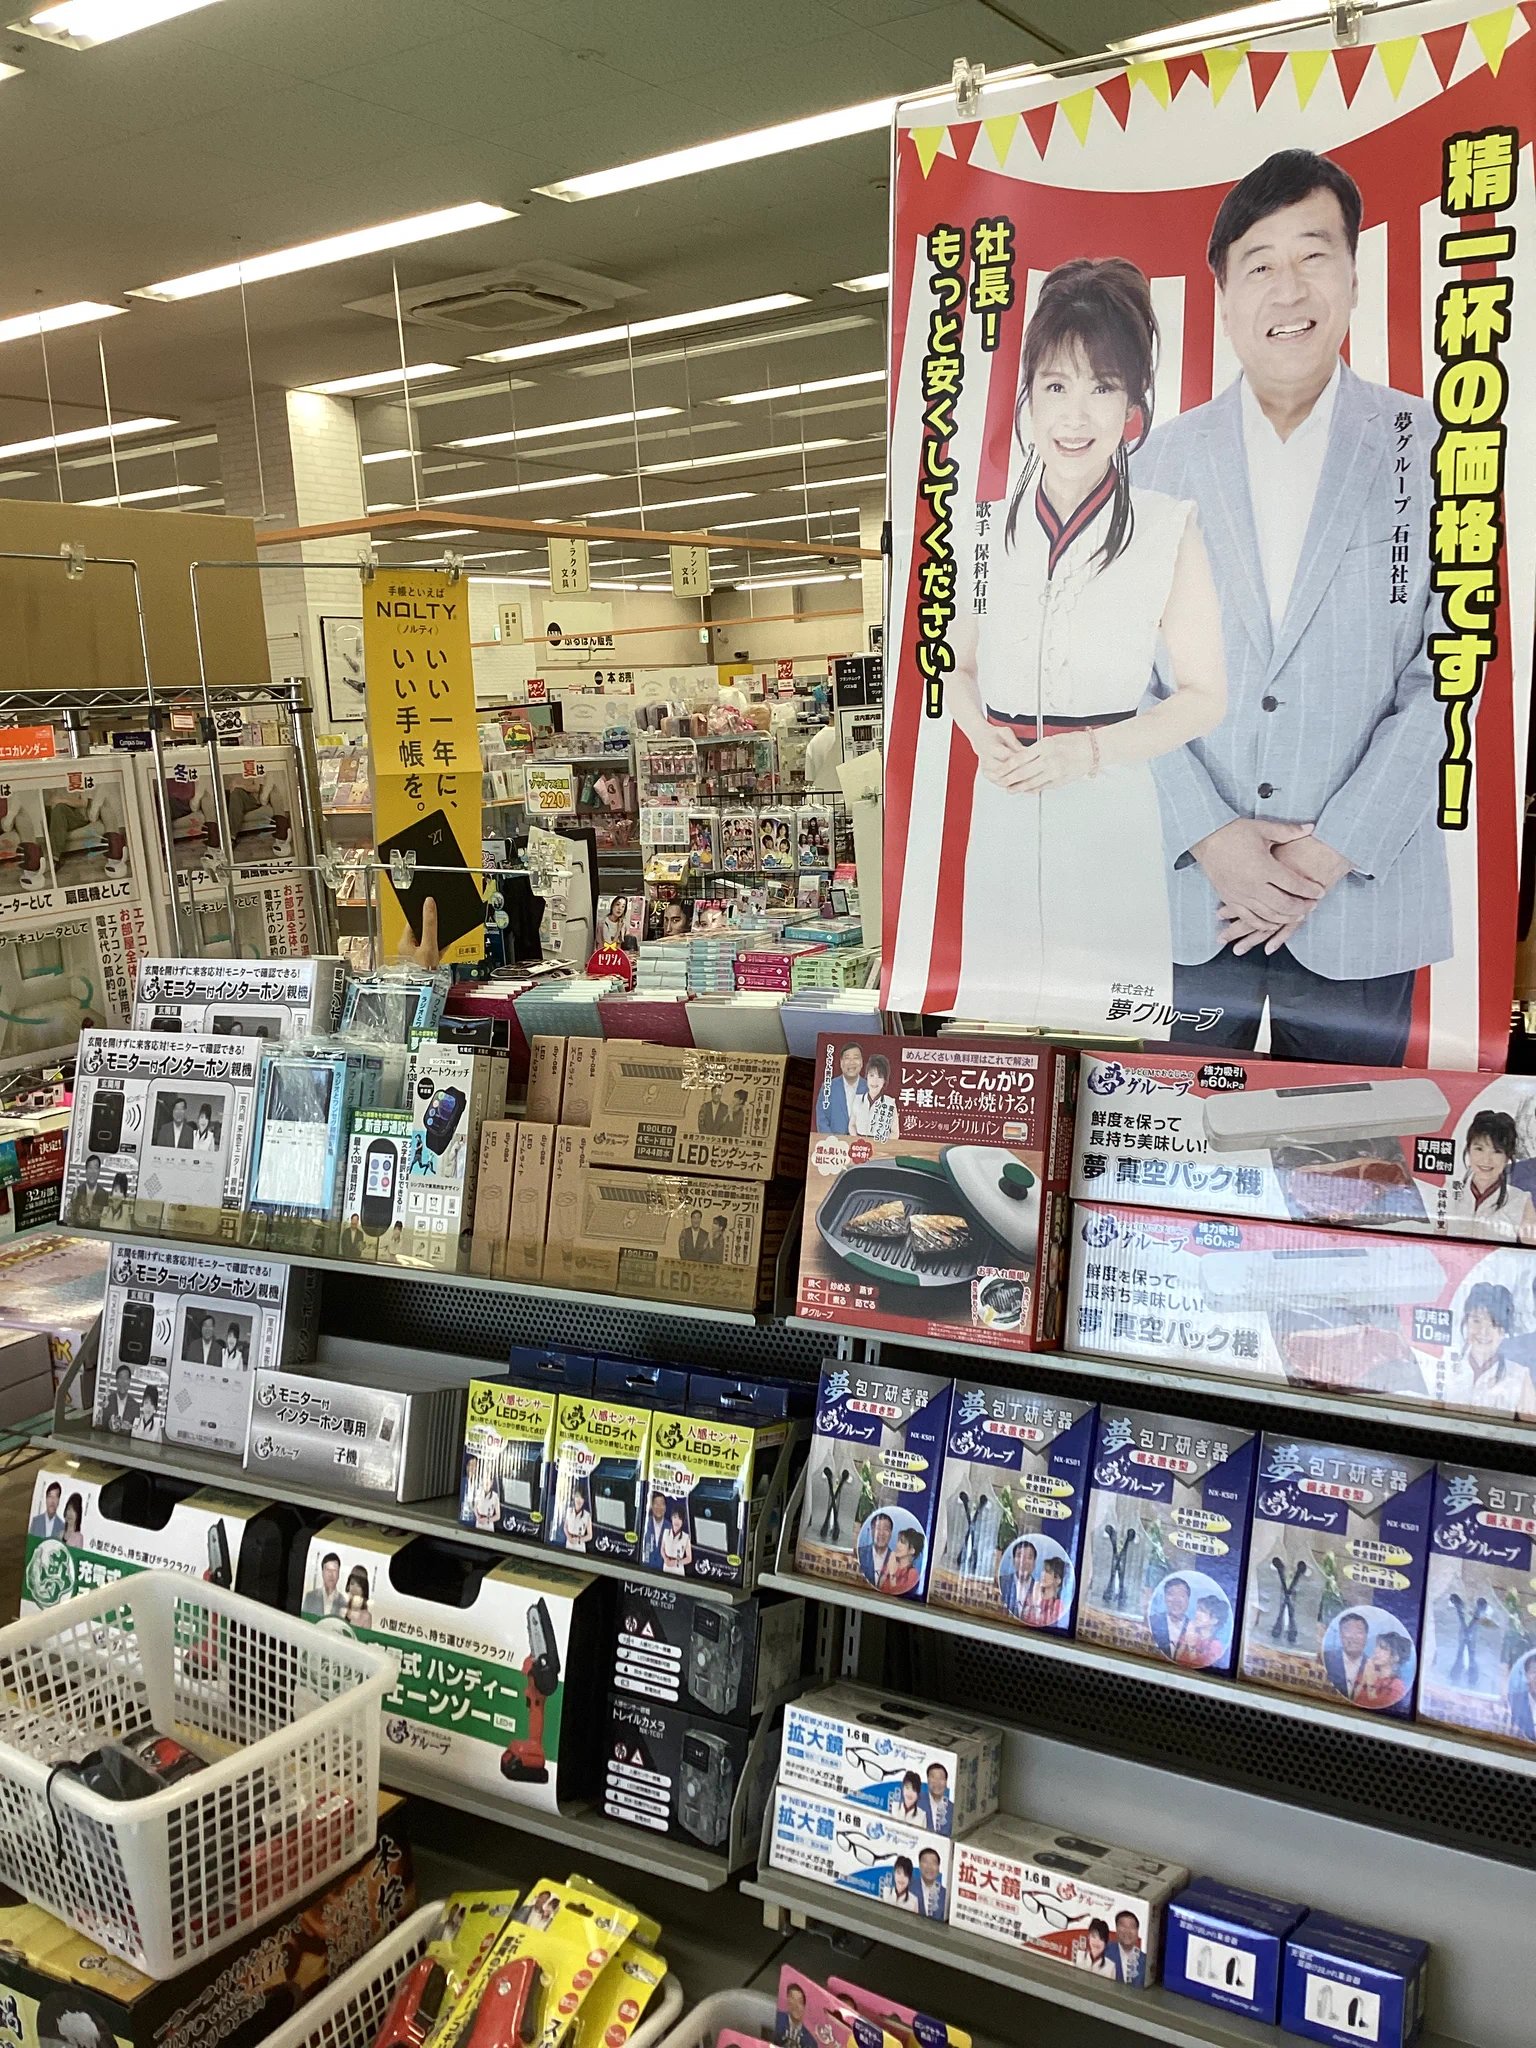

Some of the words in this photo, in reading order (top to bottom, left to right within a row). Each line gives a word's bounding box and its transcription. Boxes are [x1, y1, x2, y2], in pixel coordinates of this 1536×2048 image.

[974, 220, 1012, 349] 社長！
[918, 225, 964, 716] もっと安くしてください！
[1393, 411, 1412, 515] 夢グループ
[974, 501, 992, 537] 歌手
[569, 538, 578, 588] ャラクター
[1389, 523, 1410, 605] 石田社長
[561, 568, 570, 588] 文具
[681, 566, 690, 586] 文具
[971, 543, 990, 616] 保科有里
[387, 586, 445, 599] 手帳といえば
[376, 601, 456, 620] NOLTY
[606, 671, 616, 684] 本
[392, 648, 426, 812] いい手帳を。
[426, 648, 459, 809] いい一年に、
[174, 764, 198, 782] 冬は
[243, 760, 264, 777] 夏は
[67, 772, 95, 792] 夏は
[65, 883, 131, 905] 扇風機として
[163, 979, 284, 1001] モニター付インターホン
[286, 984, 309, 1000] 親機
[1110, 982, 1155, 997] 株式会社
[1107, 1000, 1223, 1031] 夢グループ
[106, 1052, 229, 1078] モニター付インターホン
[231, 1061, 253, 1078] 親機
[576, 1047, 584, 1062] LED
[419, 1066, 471, 1078] スマートウォッチ
[901, 1067, 1035, 1093] レンジでこんがり
[1203, 1065, 1244, 1078] 強力吸引
[898, 1087, 1036, 1115] 手軽に魚が焼ける！
[641, 1124, 673, 1135] 190LED
[1090, 1109, 1183, 1133] 鮮度を保って
[490, 1131, 498, 1147] LED
[1089, 1130, 1208, 1154] 長持ち美味しい！
[1417, 1139, 1453, 1155] 専用袋
[676, 1143, 710, 1166] LED
[711, 1145, 768, 1161] ビッグソーラー
[710, 1158, 765, 1173] センサーライト
[1083, 1153, 1108, 1180] 夢
[1116, 1156, 1263, 1196] 真空パック機
[1198, 1221, 1240, 1237] 強力吸引
[135, 1263, 257, 1298] モニター付インターホン
[257, 1283, 280, 1300] 親機
[1086, 1262, 1178, 1289] 鮮度を保って
[1084, 1282, 1204, 1313] 長持ち美味しい！
[1414, 1309, 1450, 1326] 専用袋
[1113, 1311, 1260, 1359] 真空パック機
[278, 1387, 331, 1411] モニター付
[824, 1369, 853, 1404] 夢
[855, 1379, 930, 1408] 包丁研ぎ器
[497, 1392, 551, 1410] 人感センサー
[957, 1388, 989, 1426] 夢
[991, 1399, 1074, 1431] 包丁研ぎ器
[276, 1407, 367, 1439] インターホン専用
[496, 1407, 543, 1425] LEDライト
[589, 1407, 647, 1427] 人感センサー
[587, 1421, 638, 1442] LEDライト
[686, 1425, 749, 1445] 人感センサー
[1102, 1417, 1137, 1455] 夢
[1138, 1428, 1229, 1463] 包丁研ぎ器
[334, 1446, 359, 1466] 子機
[685, 1439, 740, 1461] LEDライト
[1266, 1443, 1305, 1484] 夢
[1308, 1456, 1409, 1493] 包丁研ぎ器
[1442, 1473, 1484, 1516] 夢
[1487, 1486, 1536, 1516] 包丁
[623, 1581, 677, 1603] トレイルカメラ
[426, 1657, 519, 1700] ハンディー
[386, 1682, 491, 1723] ェーンソー
[612, 1709, 667, 1732] トレイルカメラ
[787, 1723, 844, 1757] 拡大鏡
[777, 1805, 835, 1842] 拡大鏡
[958, 1862, 1022, 1901] 拡大鏡
